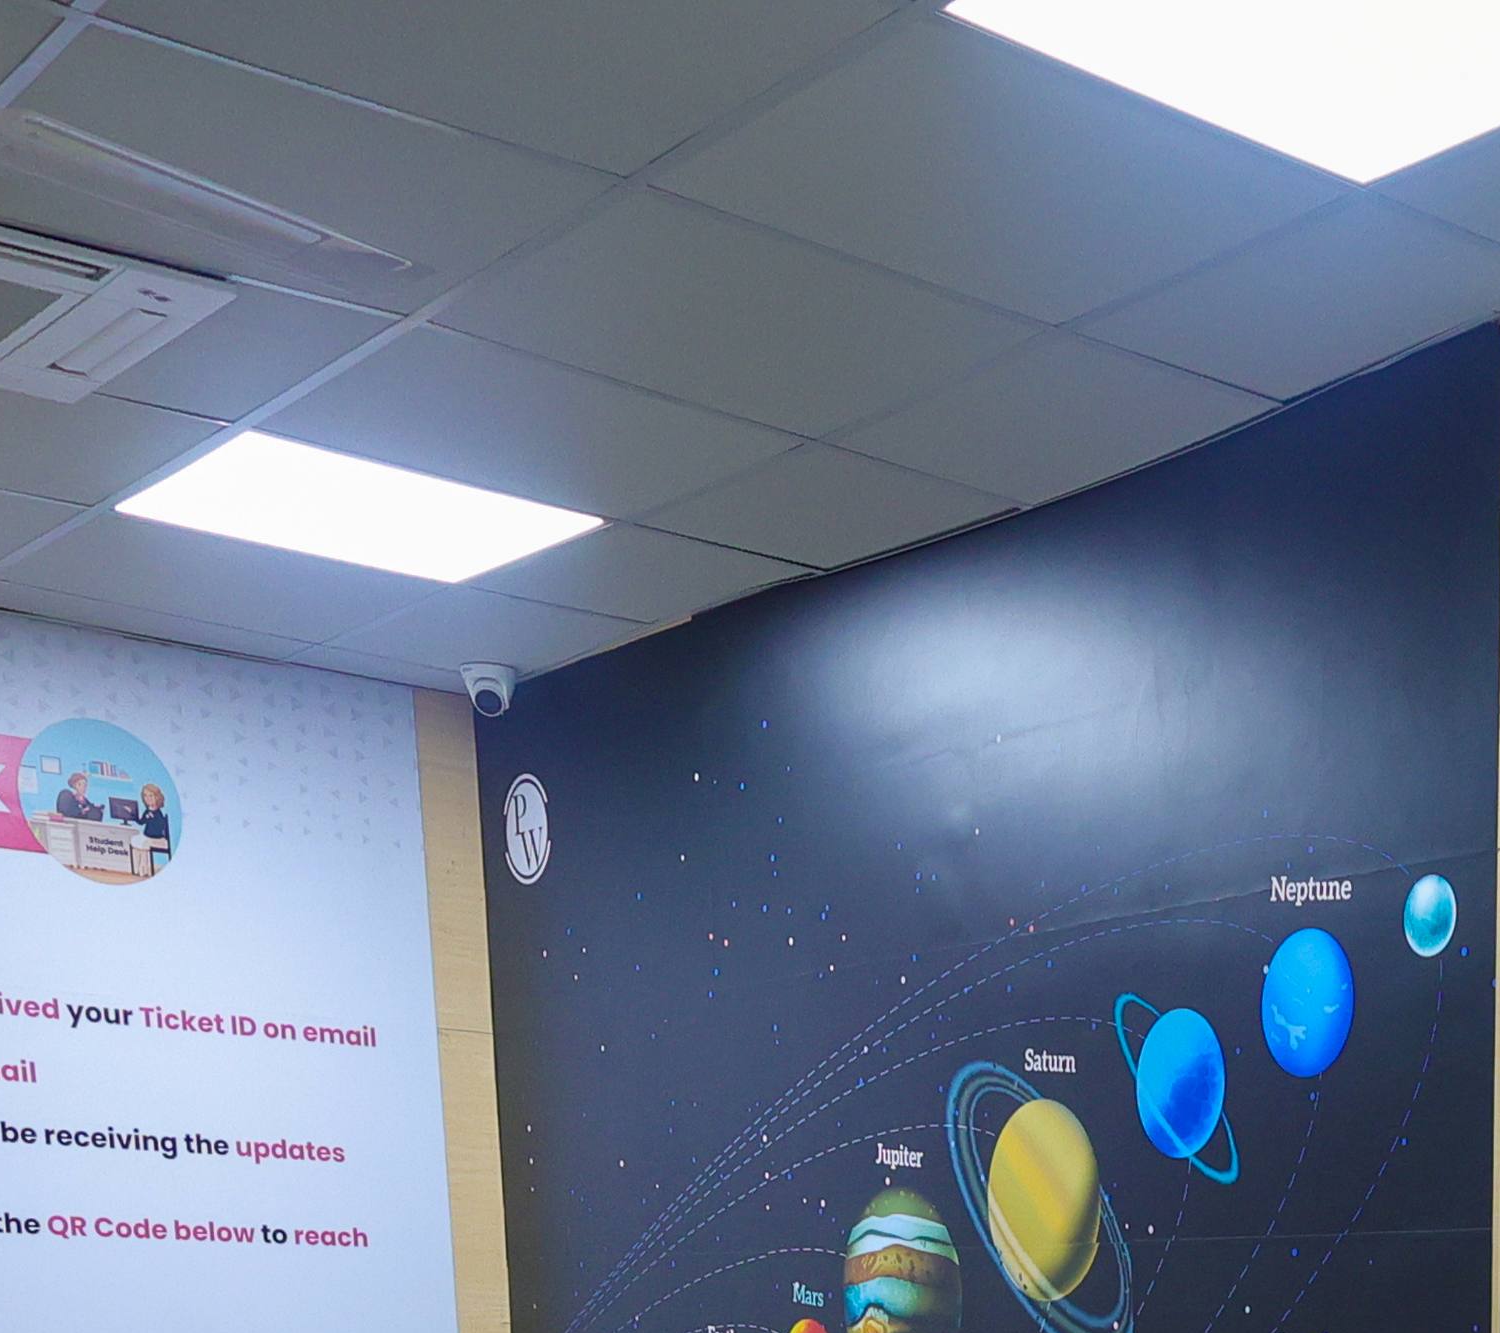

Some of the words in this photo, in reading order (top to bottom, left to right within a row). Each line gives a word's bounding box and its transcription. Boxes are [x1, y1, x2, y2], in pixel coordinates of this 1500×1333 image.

[86, 845, 106, 854] Help
[108, 847, 128, 856] Desk
[89, 836, 124, 848] Student
[1269, 875, 1352, 907] Neptune
[65, 1003, 134, 1029] your
[138, 1005, 226, 1035] Ticket
[230, 1014, 258, 1037] ID
[262, 1021, 297, 1041] on
[302, 1024, 377, 1048] email
[1024, 1049, 1077, 1075] Saturn
[0, 1120, 38, 1145] be
[43, 1125, 179, 1161] receiving
[183, 1132, 230, 1156] the
[235, 1138, 346, 1165] updates
[875, 1143, 924, 1170] Jupiter
[46, 1214, 88, 1240] QR
[93, 1216, 168, 1241] Code
[173, 1219, 256, 1244] below
[260, 1224, 289, 1245] to
[293, 1226, 369, 1248] reach
[793, 1282, 824, 1307] Mars
